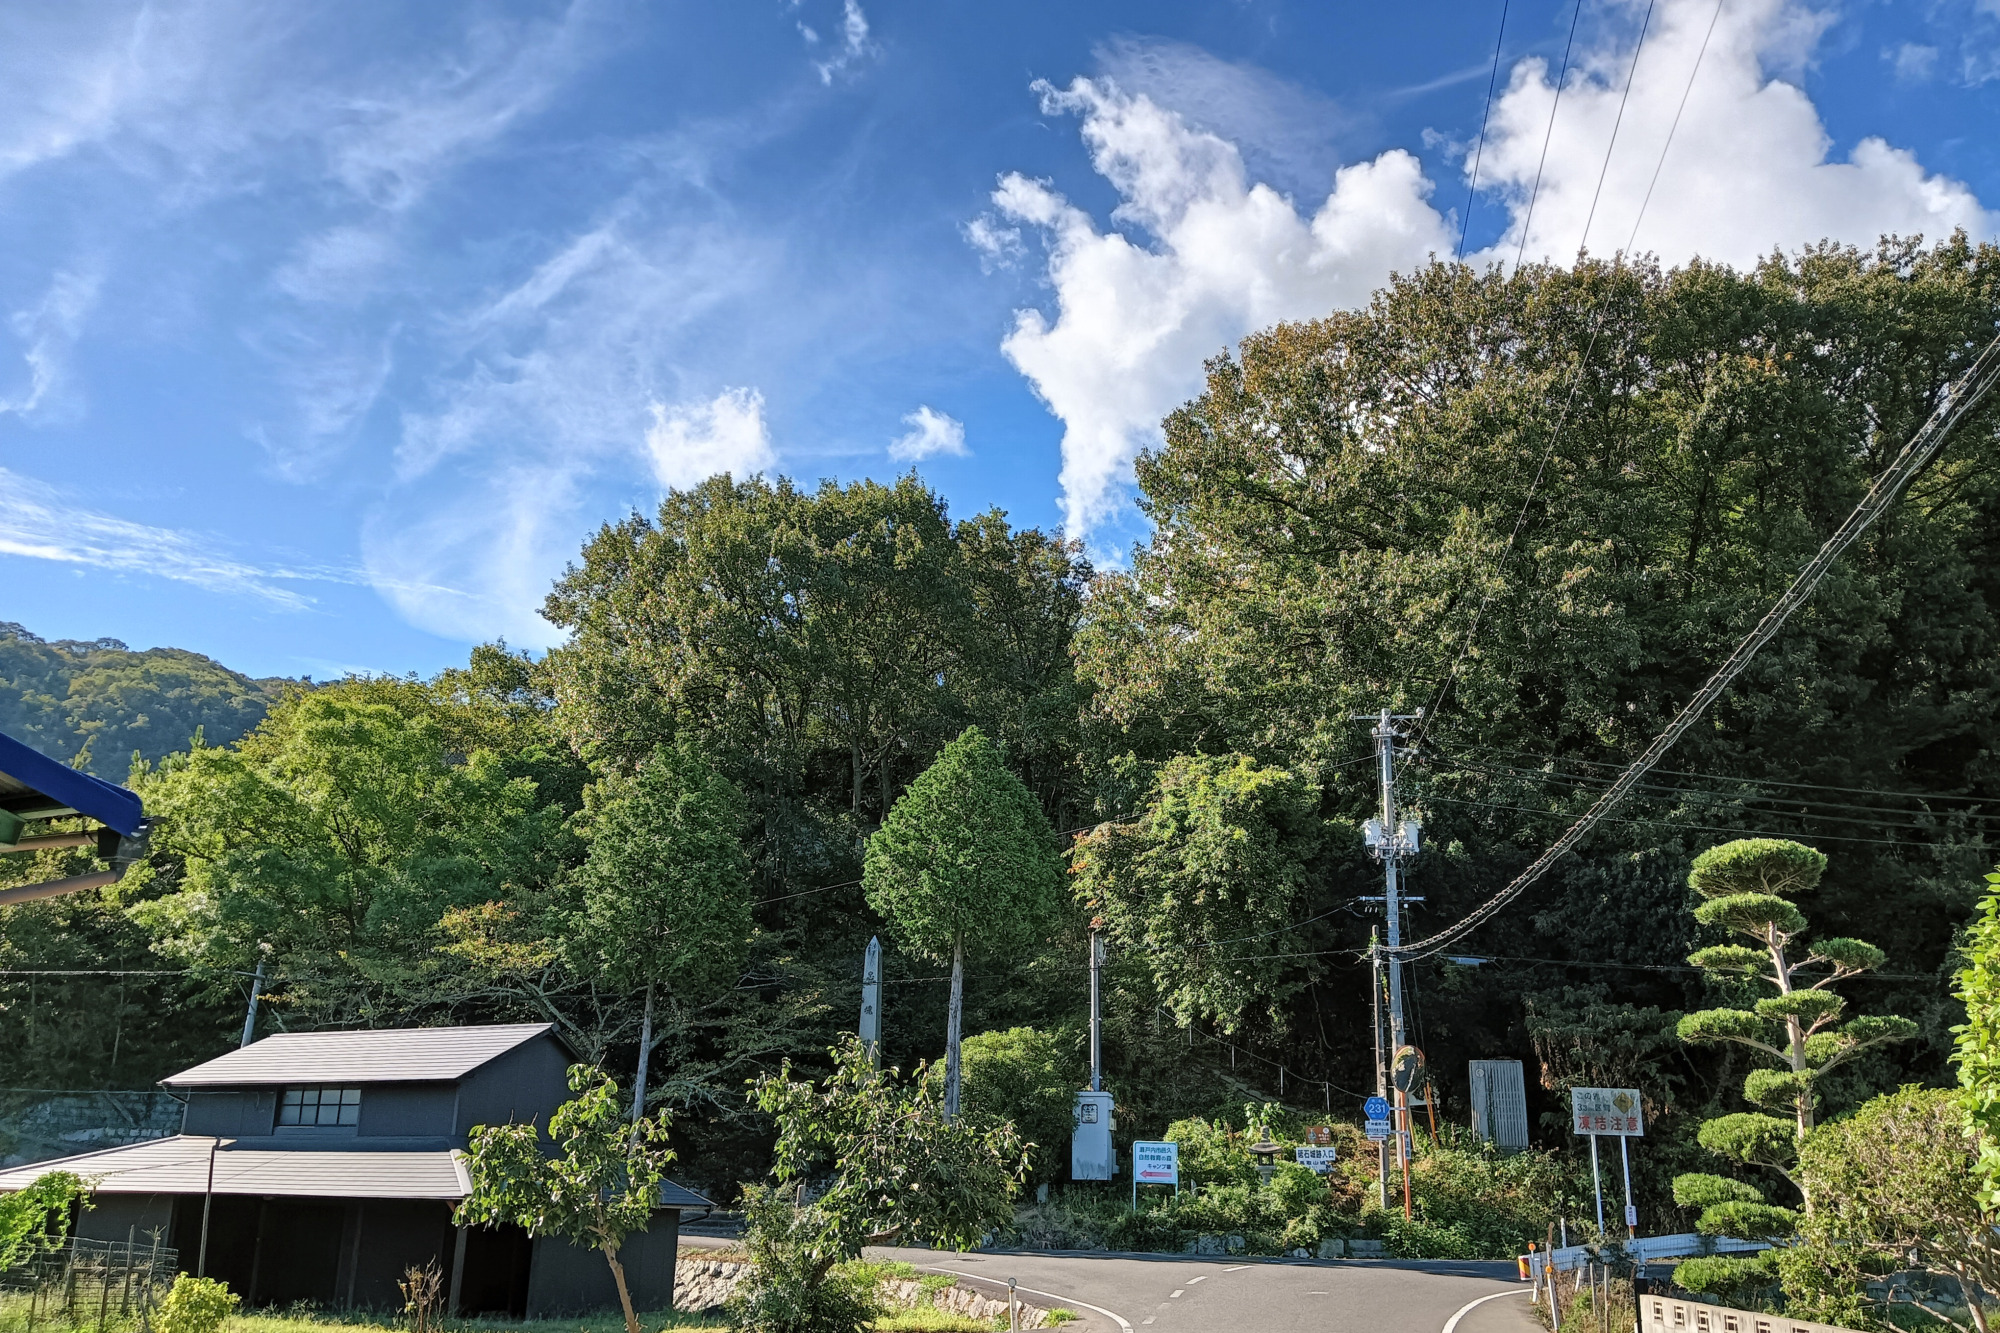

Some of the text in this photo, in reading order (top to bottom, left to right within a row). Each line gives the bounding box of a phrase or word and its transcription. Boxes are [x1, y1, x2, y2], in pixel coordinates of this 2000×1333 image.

[1368, 1103, 1386, 1114] 231
[1578, 1115, 1639, 1132] 凍結注意
